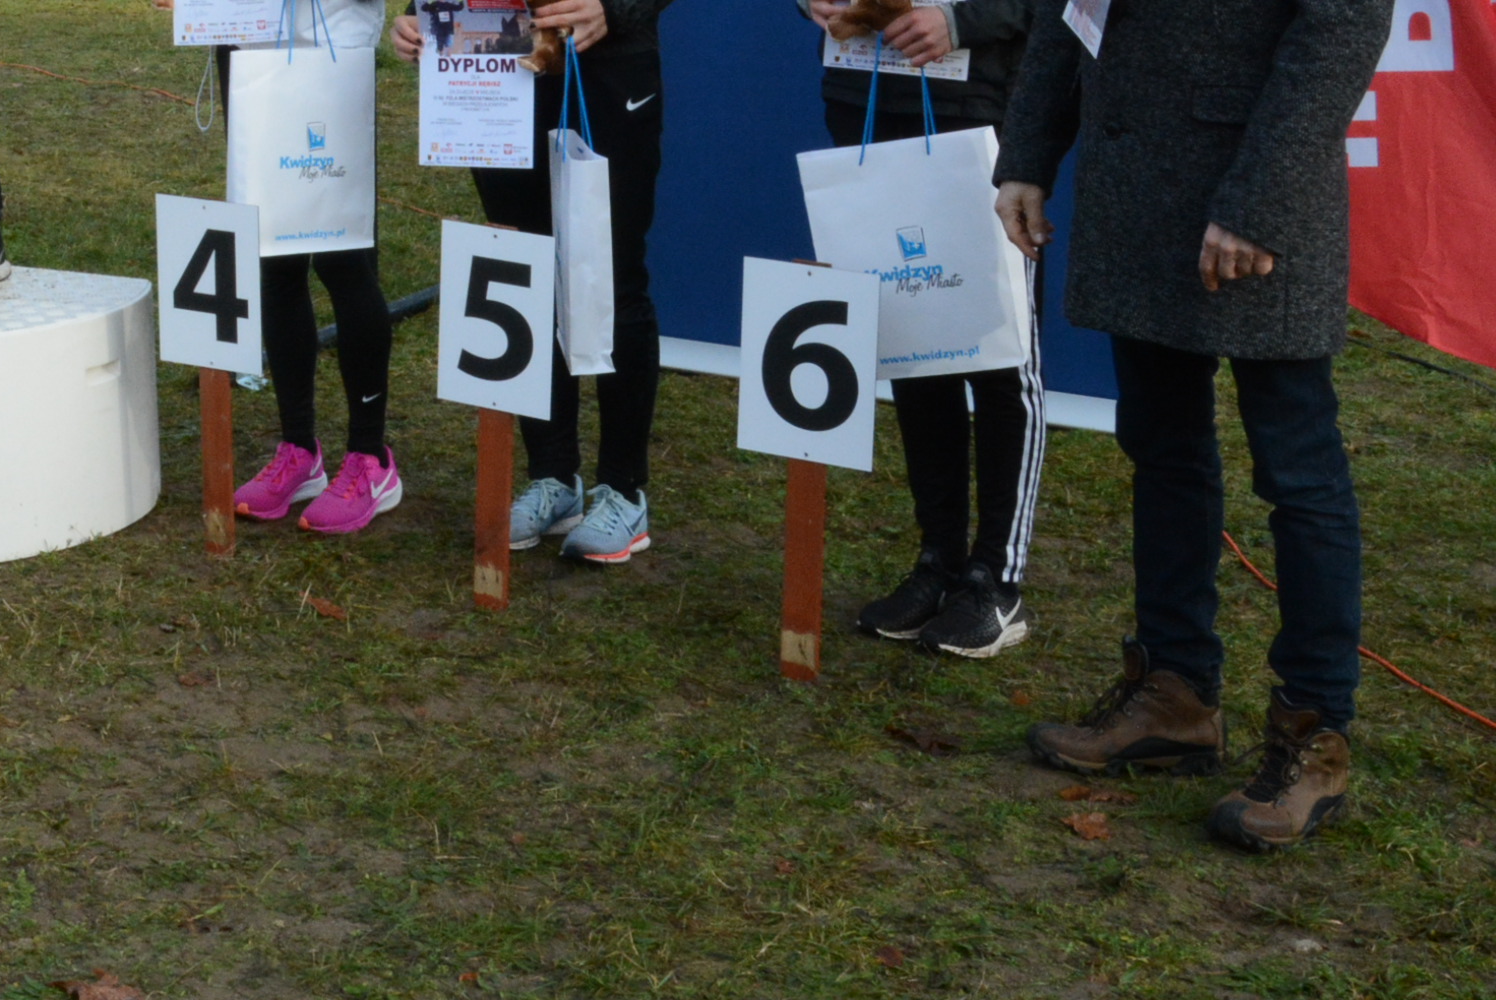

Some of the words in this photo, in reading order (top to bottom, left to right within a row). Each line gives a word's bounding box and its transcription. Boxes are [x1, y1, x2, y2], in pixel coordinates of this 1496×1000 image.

[437, 57, 517, 74] DYPLOM
[279, 154, 335, 171] Kwidzyn
[274, 228, 346, 241] www.kwidzyn.pl
[173, 228, 249, 345] 4
[896, 278, 924, 298] Moje
[926, 273, 964, 291] Miasto
[456, 254, 534, 382] 5
[761, 299, 860, 432] 6
[878, 346, 981, 365] www.kwidzyn.pl
